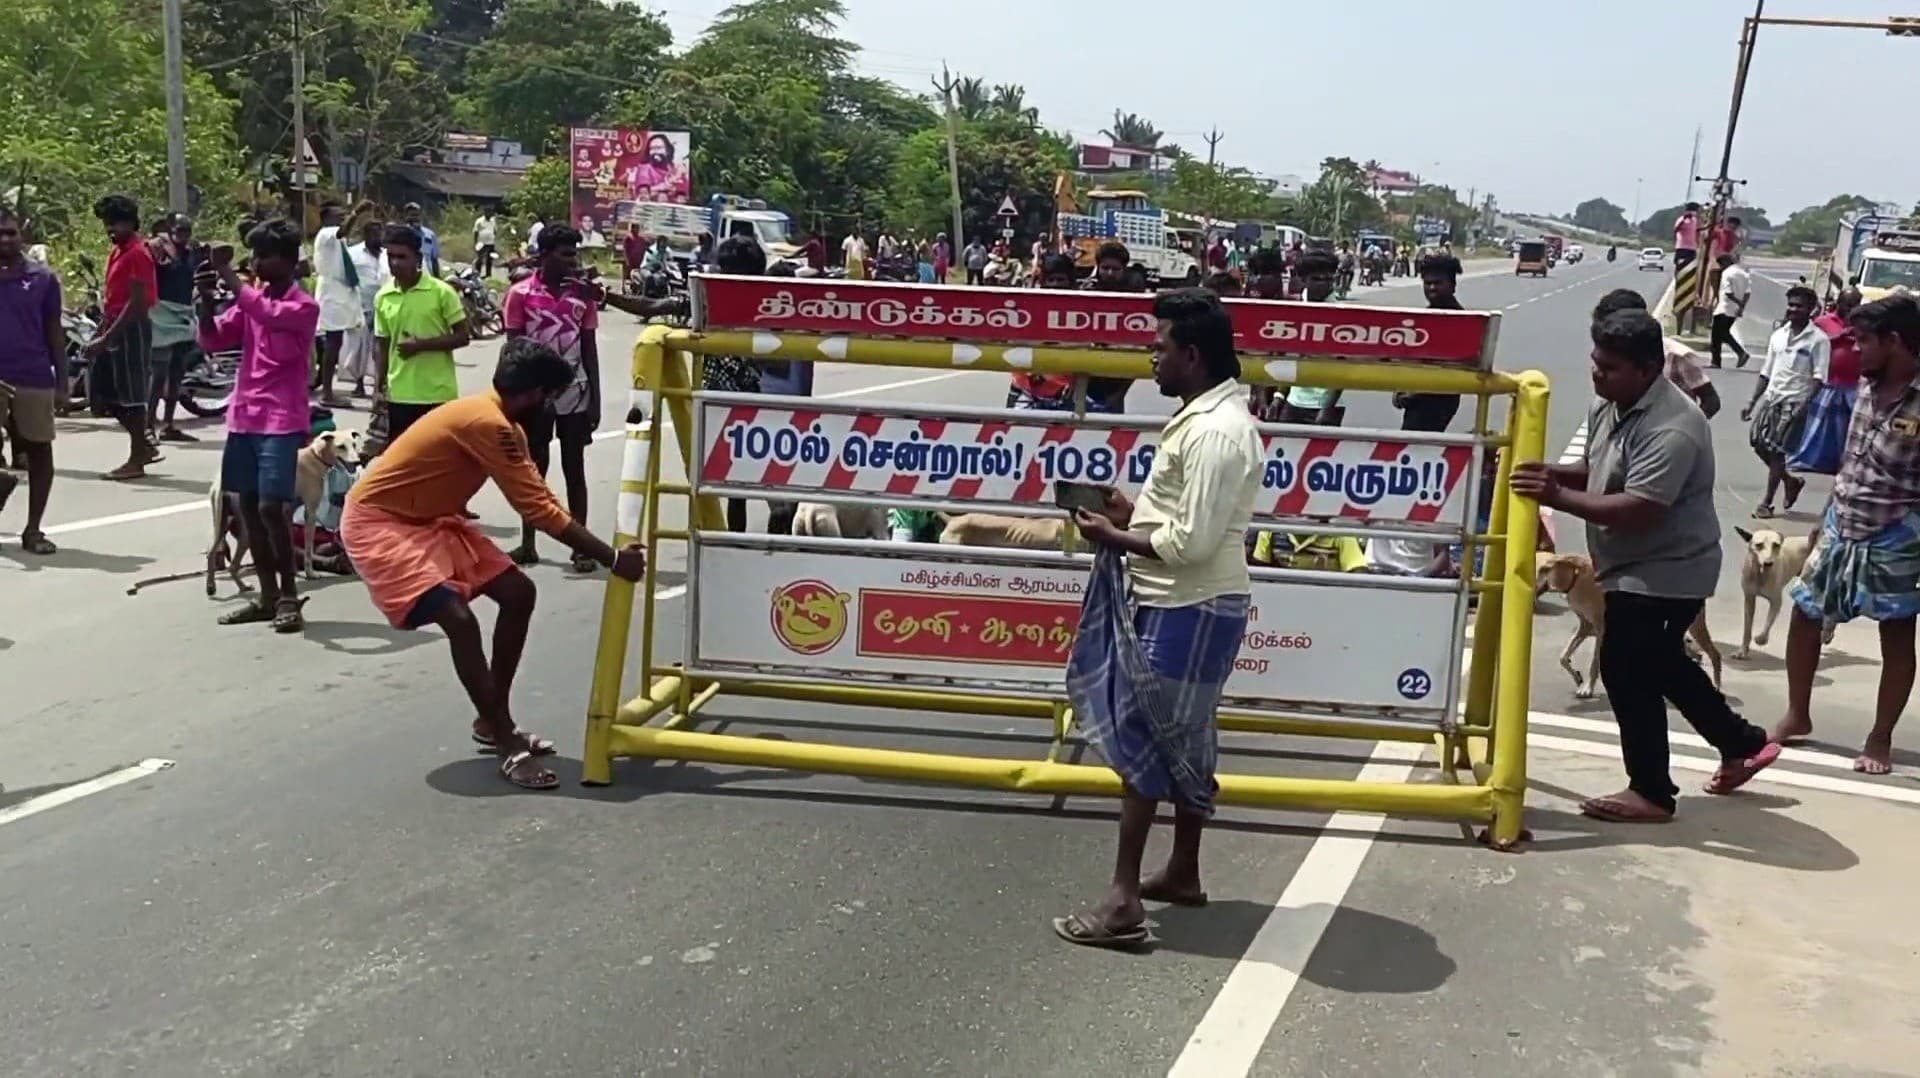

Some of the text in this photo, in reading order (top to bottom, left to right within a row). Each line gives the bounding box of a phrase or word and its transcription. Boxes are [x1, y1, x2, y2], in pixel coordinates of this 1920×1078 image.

[754, 291, 1031, 328] திண்டுக்கல்
[1259, 318, 1430, 347] காவல்
[727, 424, 830, 464] 100ல்
[843, 430, 1024, 483] சென்றால்!
[1039, 445, 1113, 481] 108
[1307, 454, 1444, 504] வரும்!!
[900, 569, 1000, 588] மகிழ்ச்சியின்
[873, 609, 960, 644] தேனி
[1401, 676, 1428, 693] 22
